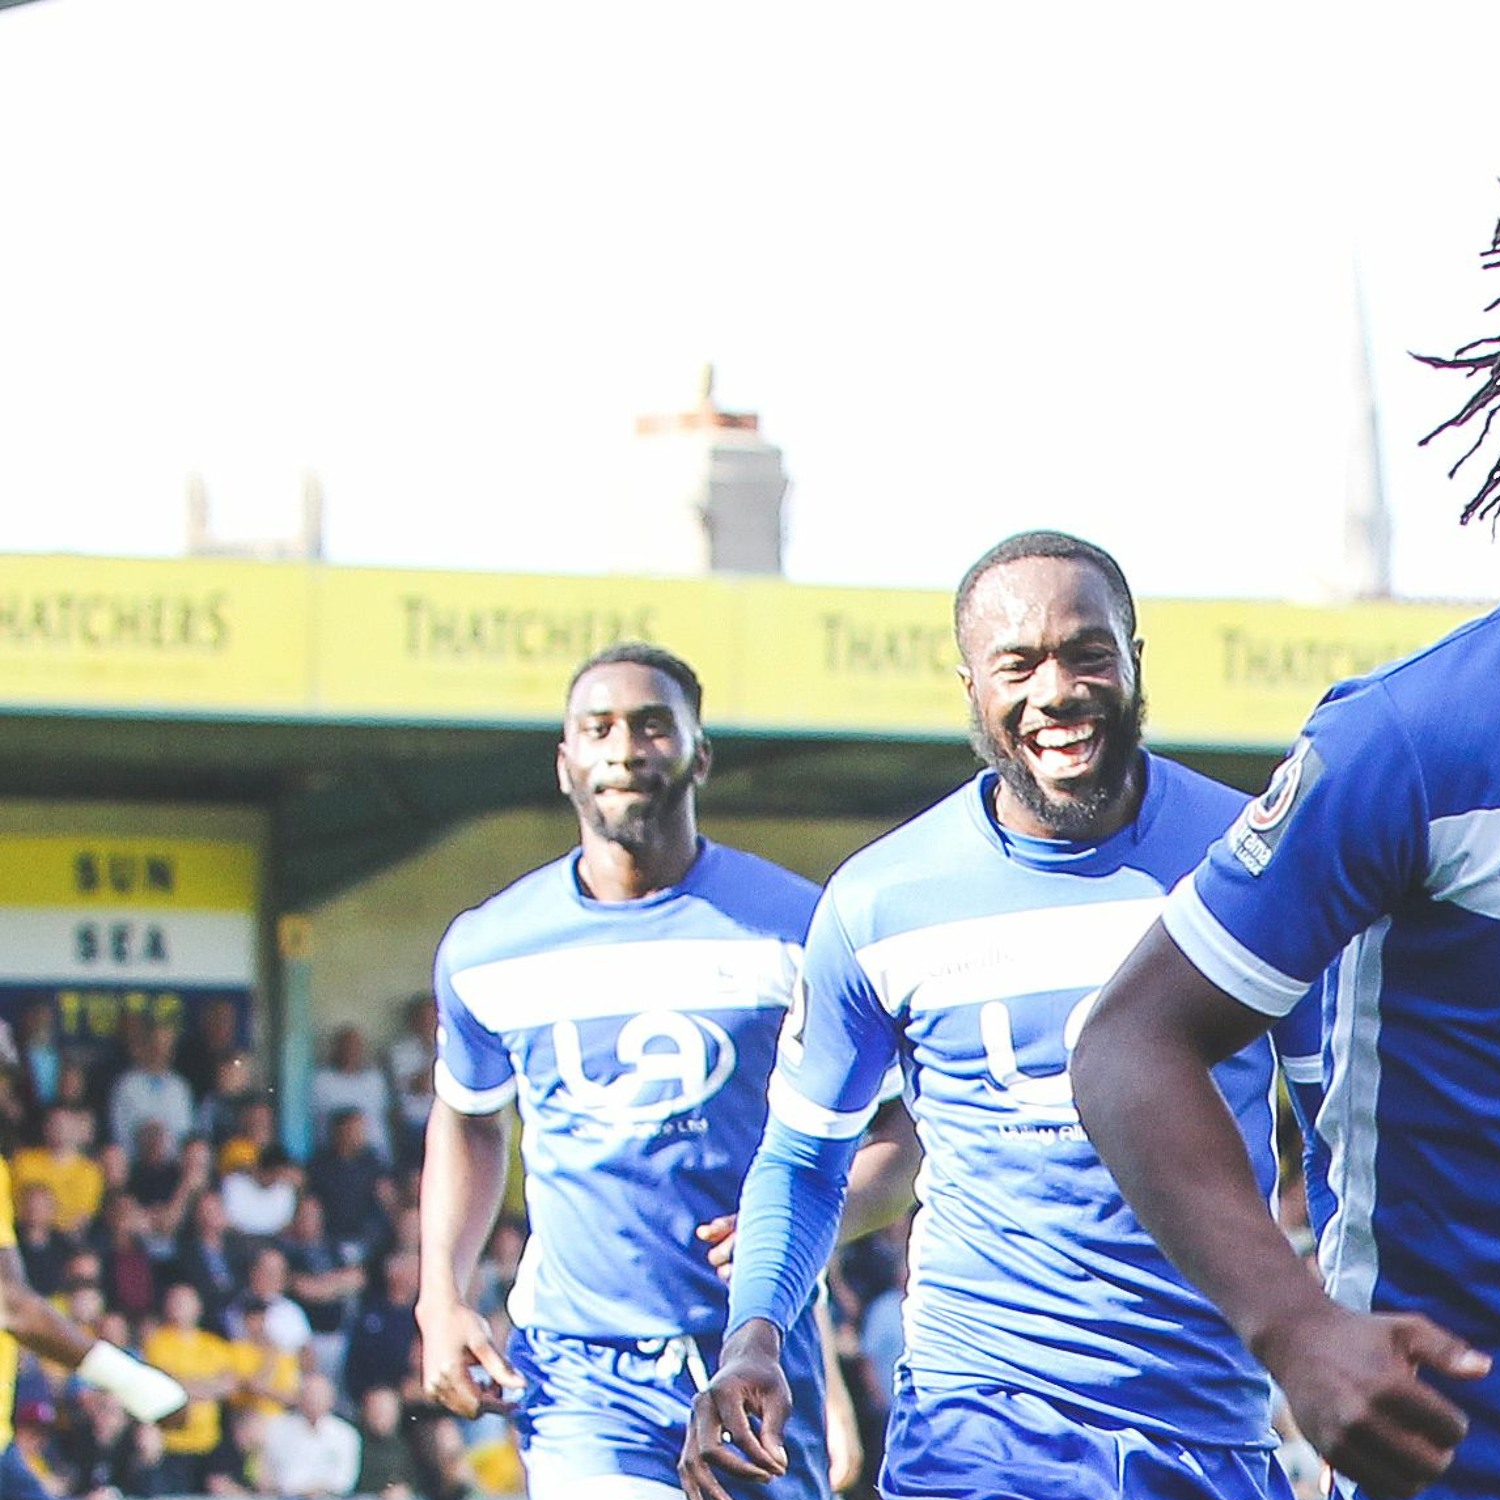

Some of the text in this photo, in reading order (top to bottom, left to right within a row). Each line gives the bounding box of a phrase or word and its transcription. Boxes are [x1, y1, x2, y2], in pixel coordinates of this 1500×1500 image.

[0, 591, 231, 654] HATCHERS
[400, 597, 658, 660] THATCHERS
[820, 612, 955, 677] THATC
[75, 852, 174, 894] SUN
[75, 922, 168, 961] SEA
